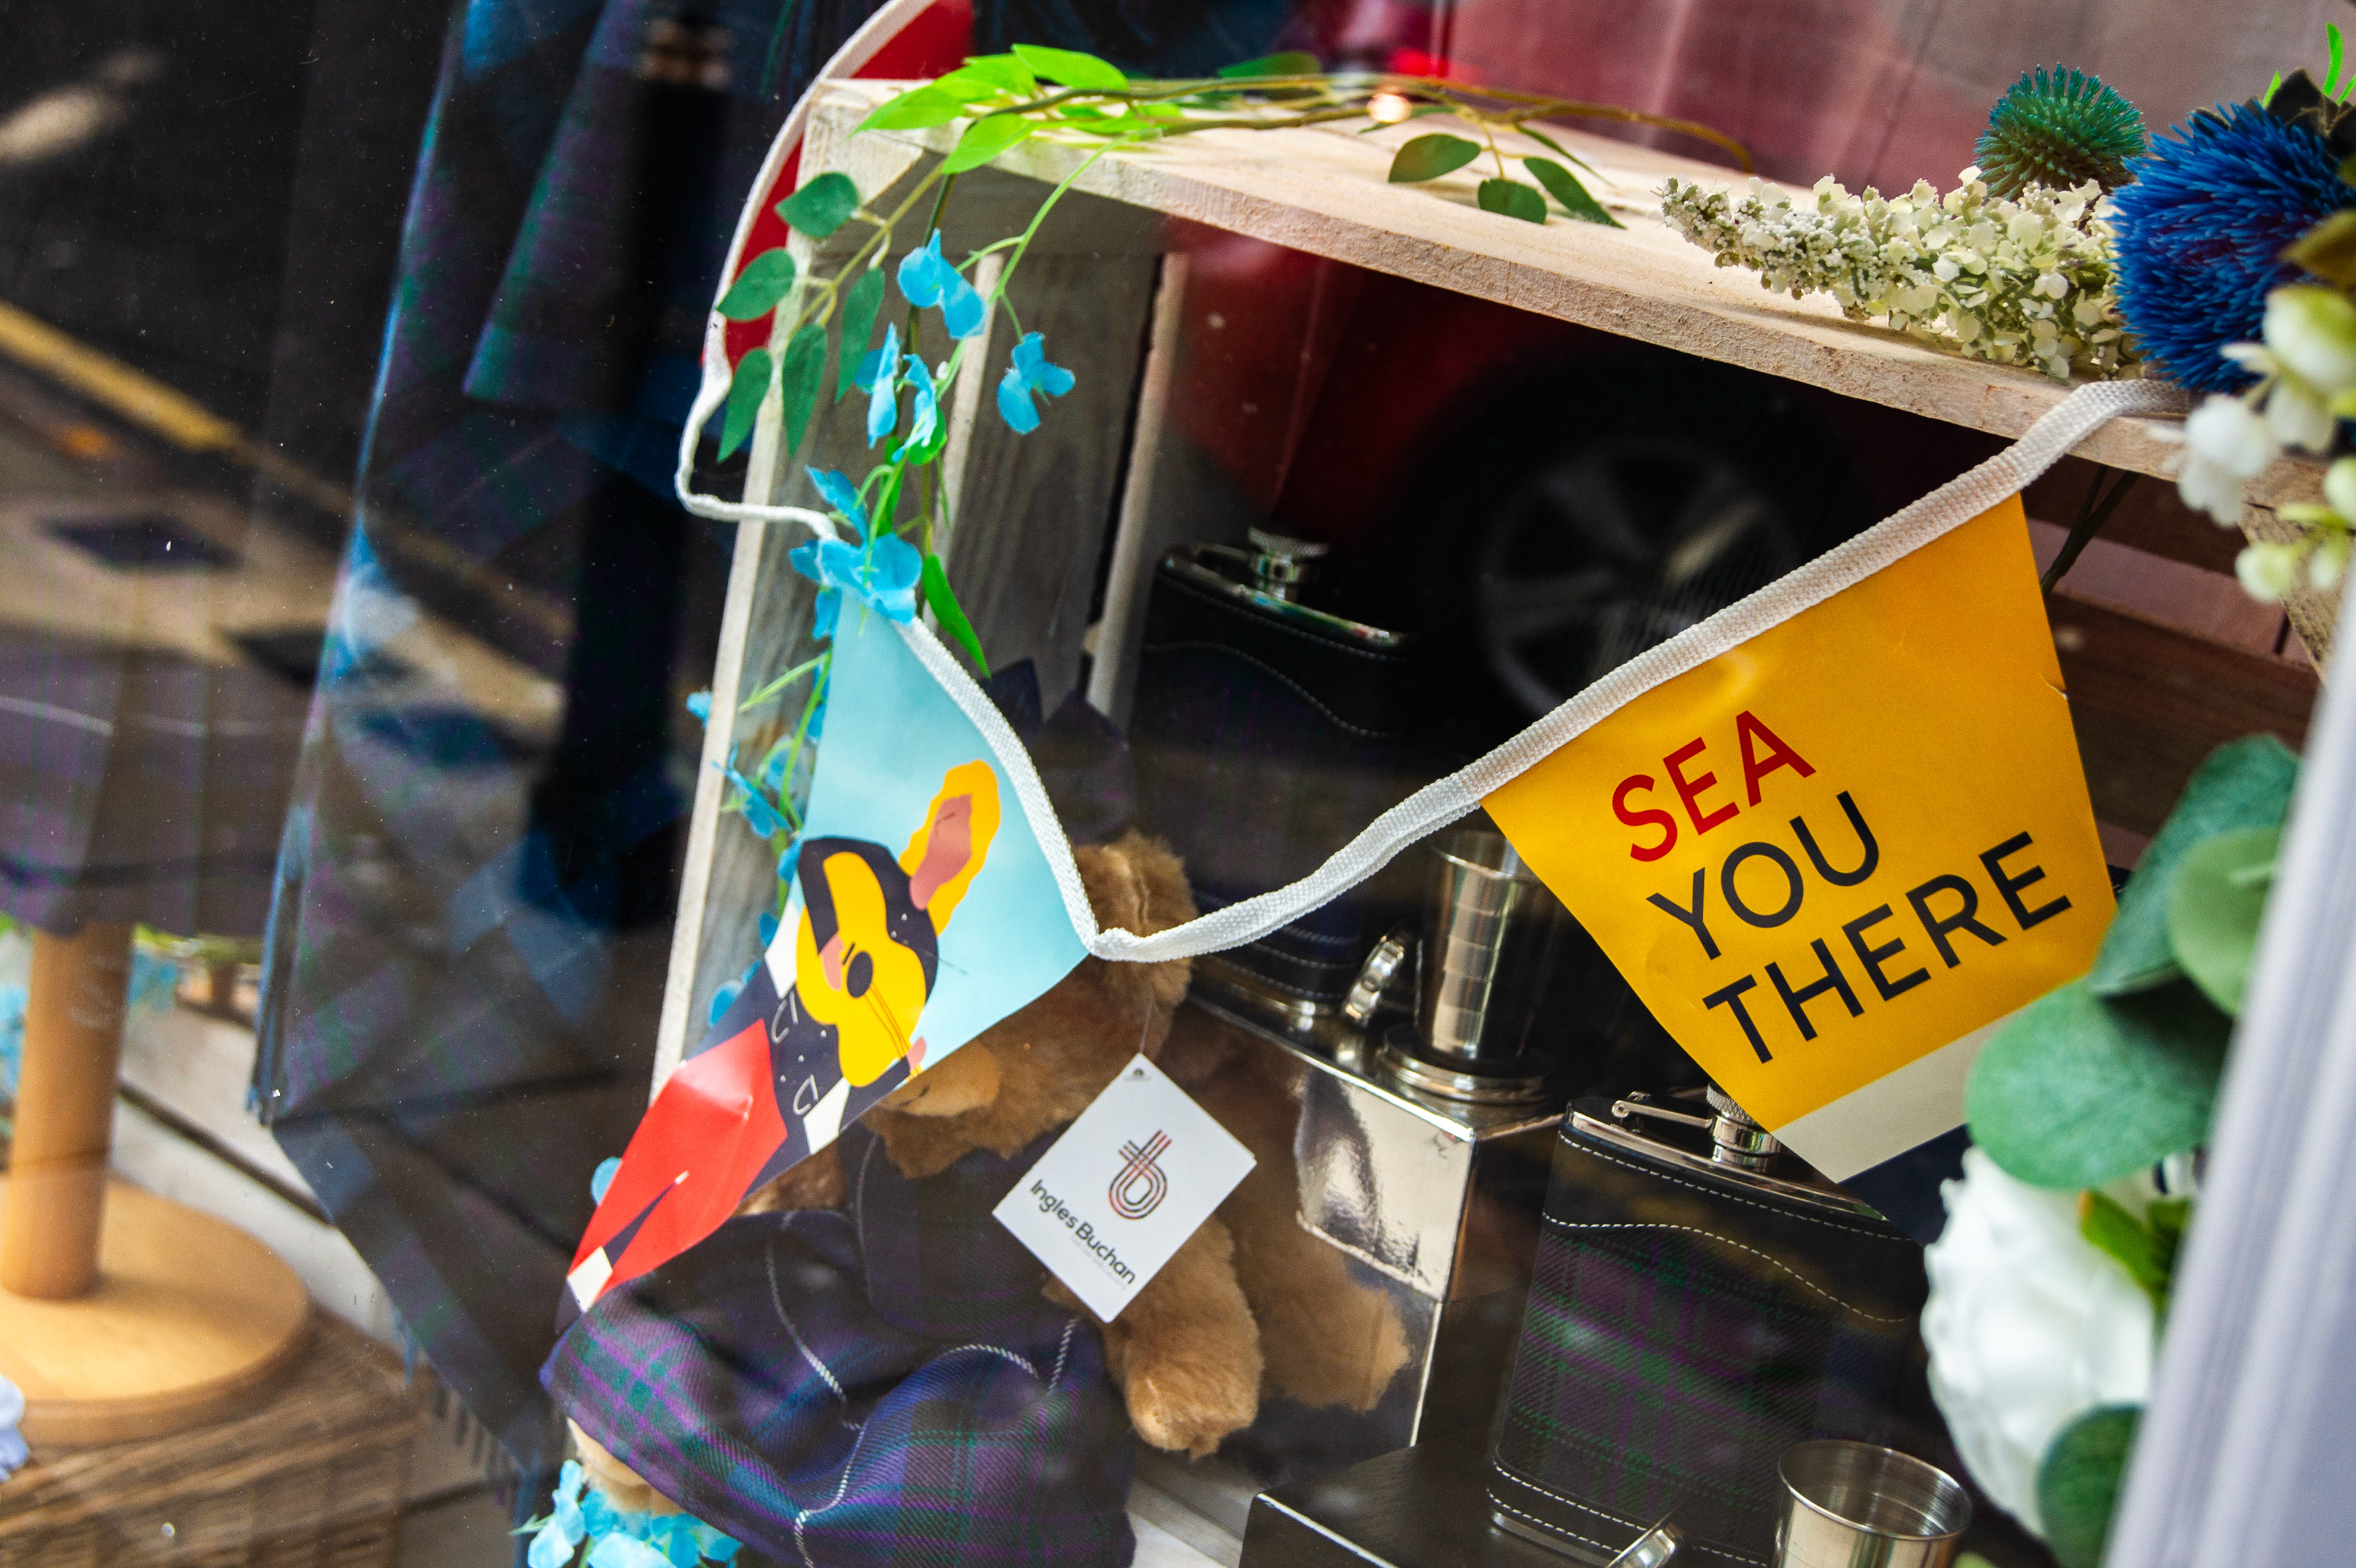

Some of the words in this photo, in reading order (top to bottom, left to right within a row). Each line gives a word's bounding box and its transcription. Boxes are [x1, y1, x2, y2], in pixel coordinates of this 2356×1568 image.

[1612, 710, 1816, 861] SEA
[1646, 790, 1879, 960] YOU
[1702, 831, 2073, 1064] THERE
[1030, 1178, 1078, 1229] Ingles
[1075, 1221, 1136, 1285] Buchan
